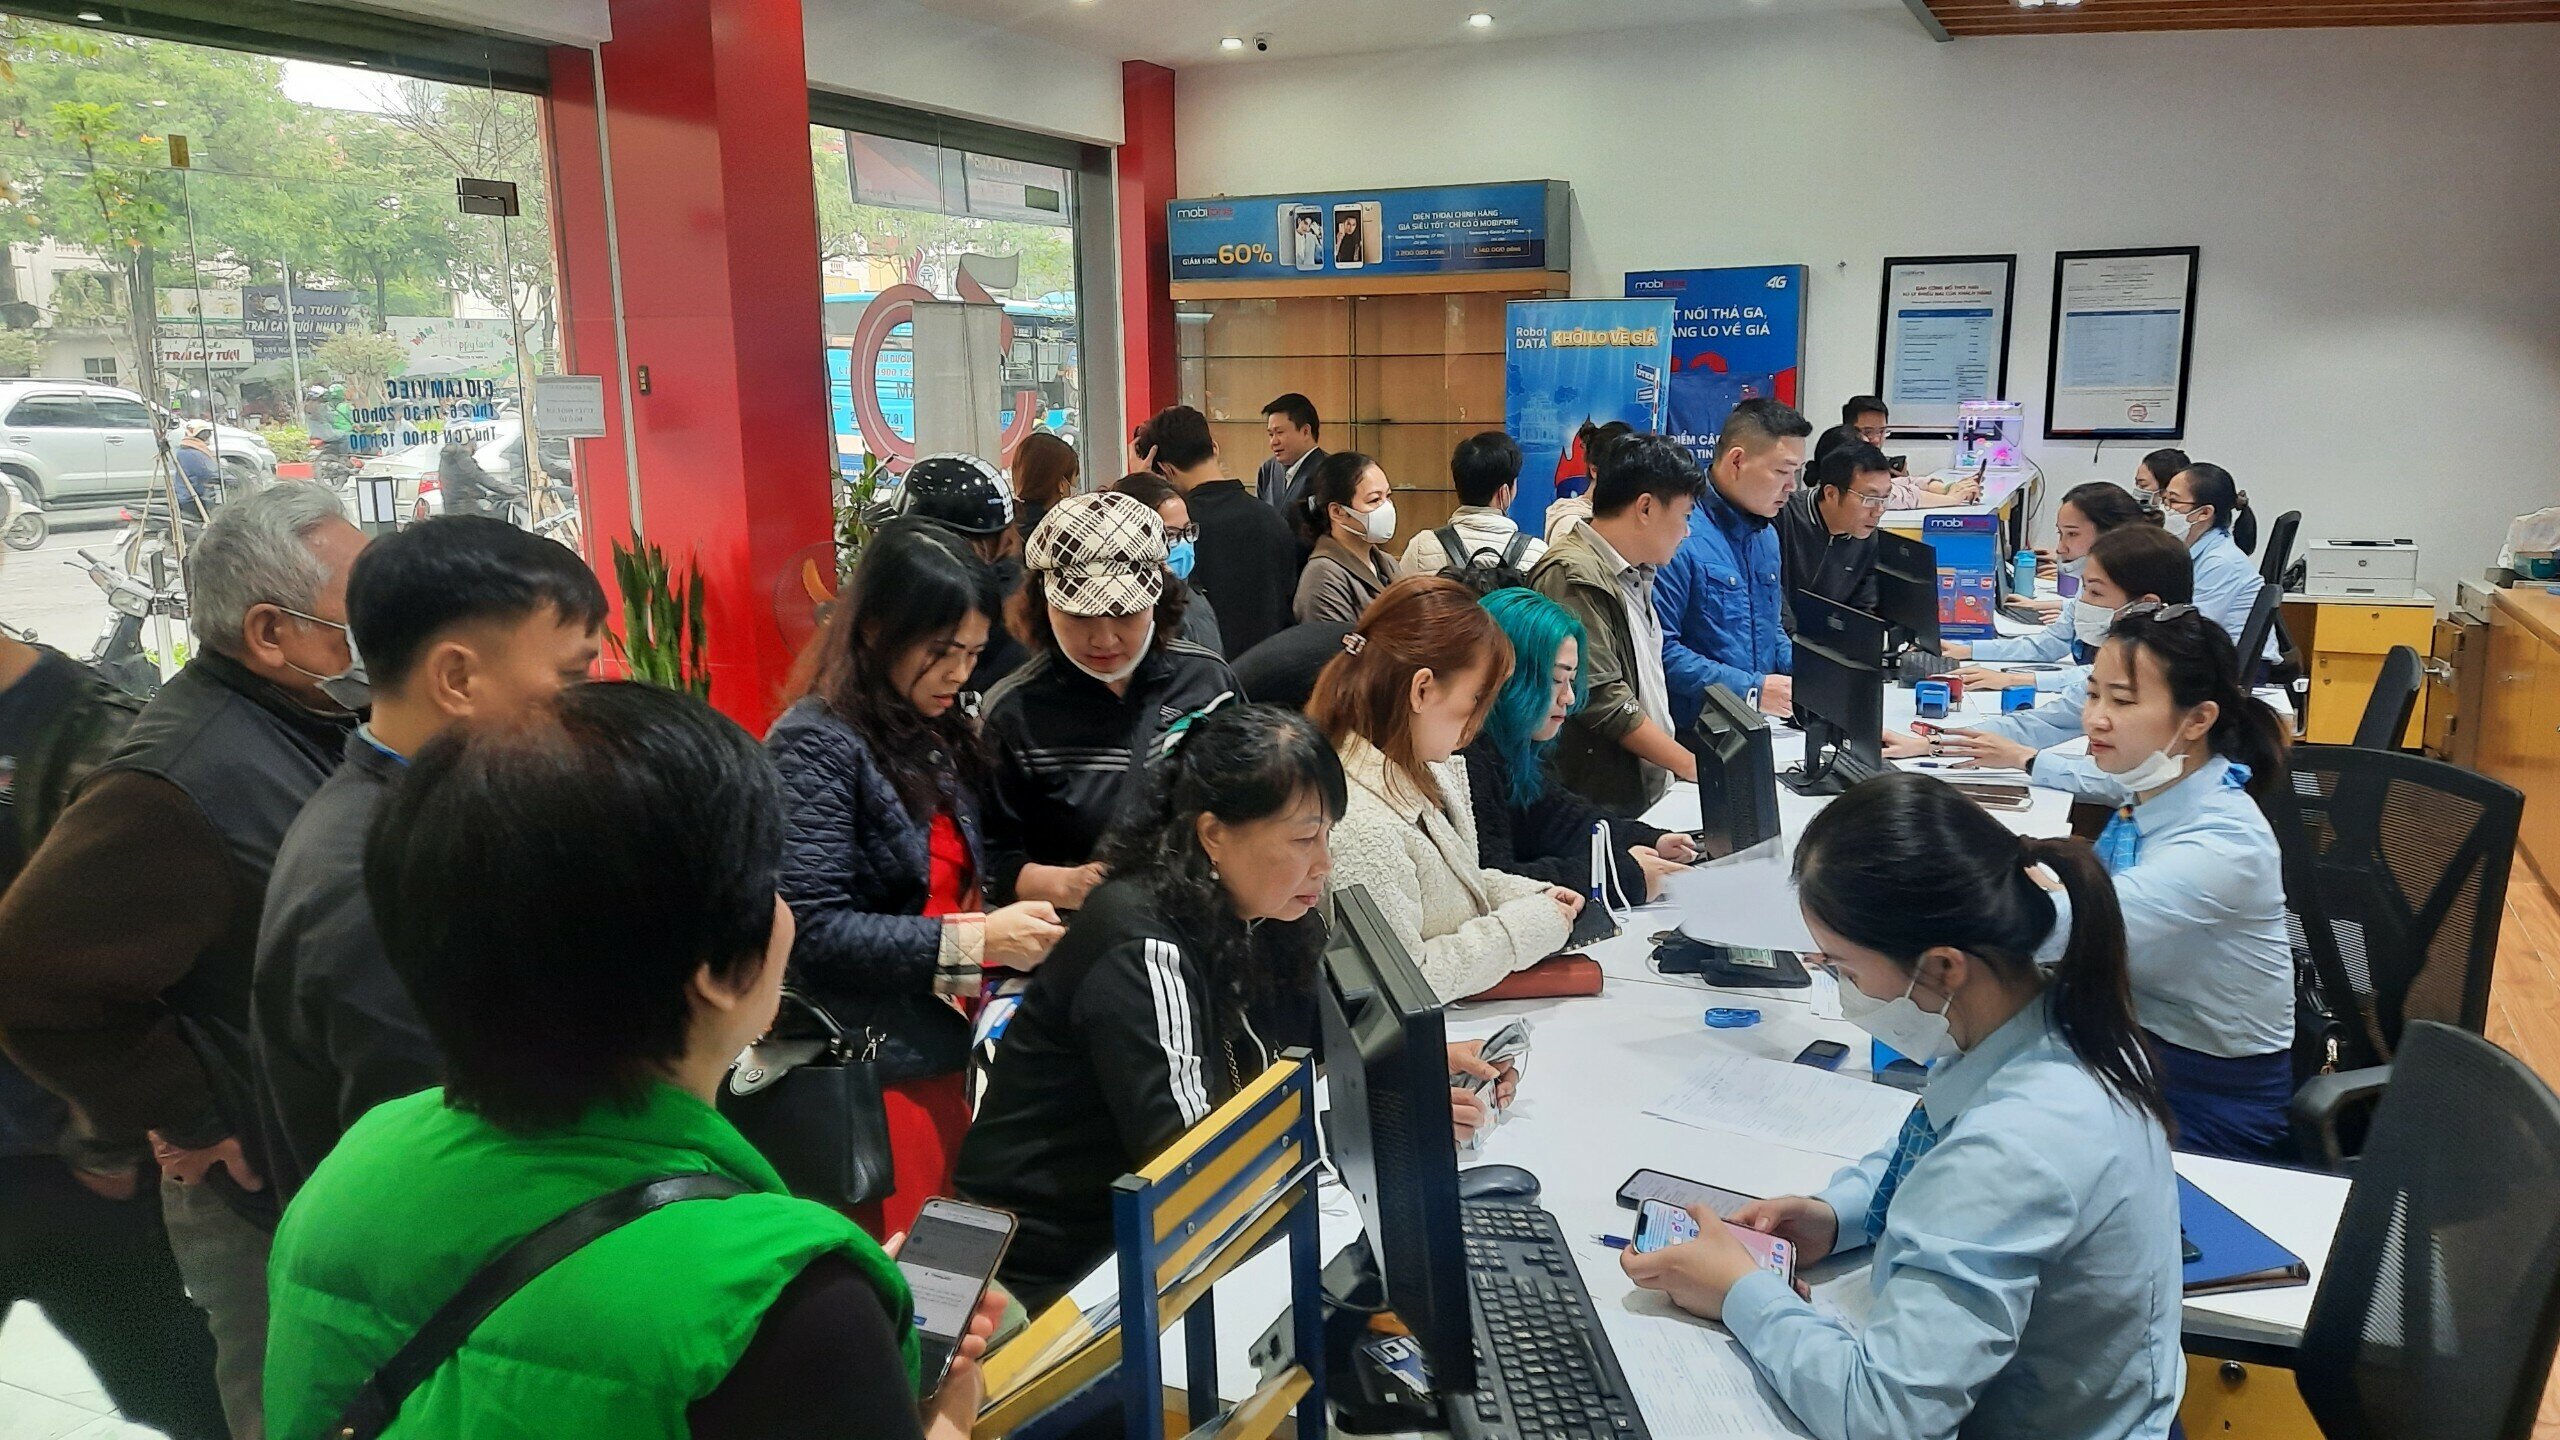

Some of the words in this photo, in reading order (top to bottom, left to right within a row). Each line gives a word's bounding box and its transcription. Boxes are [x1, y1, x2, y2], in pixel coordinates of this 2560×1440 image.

[1218, 243, 1273, 265] 60%
[1766, 275, 1787, 289] 4G
[1684, 304, 1708, 320] NỐI
[1711, 303, 1740, 320] THẢ
[1744, 306, 1768, 320] GA,
[1515, 326, 1548, 337] Robot
[1588, 331, 1607, 345] LO
[1609, 327, 1630, 345] VỀ
[1632, 327, 1657, 346] GIÁ
[1701, 325, 1719, 337] LO
[1722, 321, 1741, 336] VỀ
[1745, 321, 1771, 336] GIÁ
[1515, 338, 1548, 349] DATA
[1696, 449, 1714, 459] TIN
